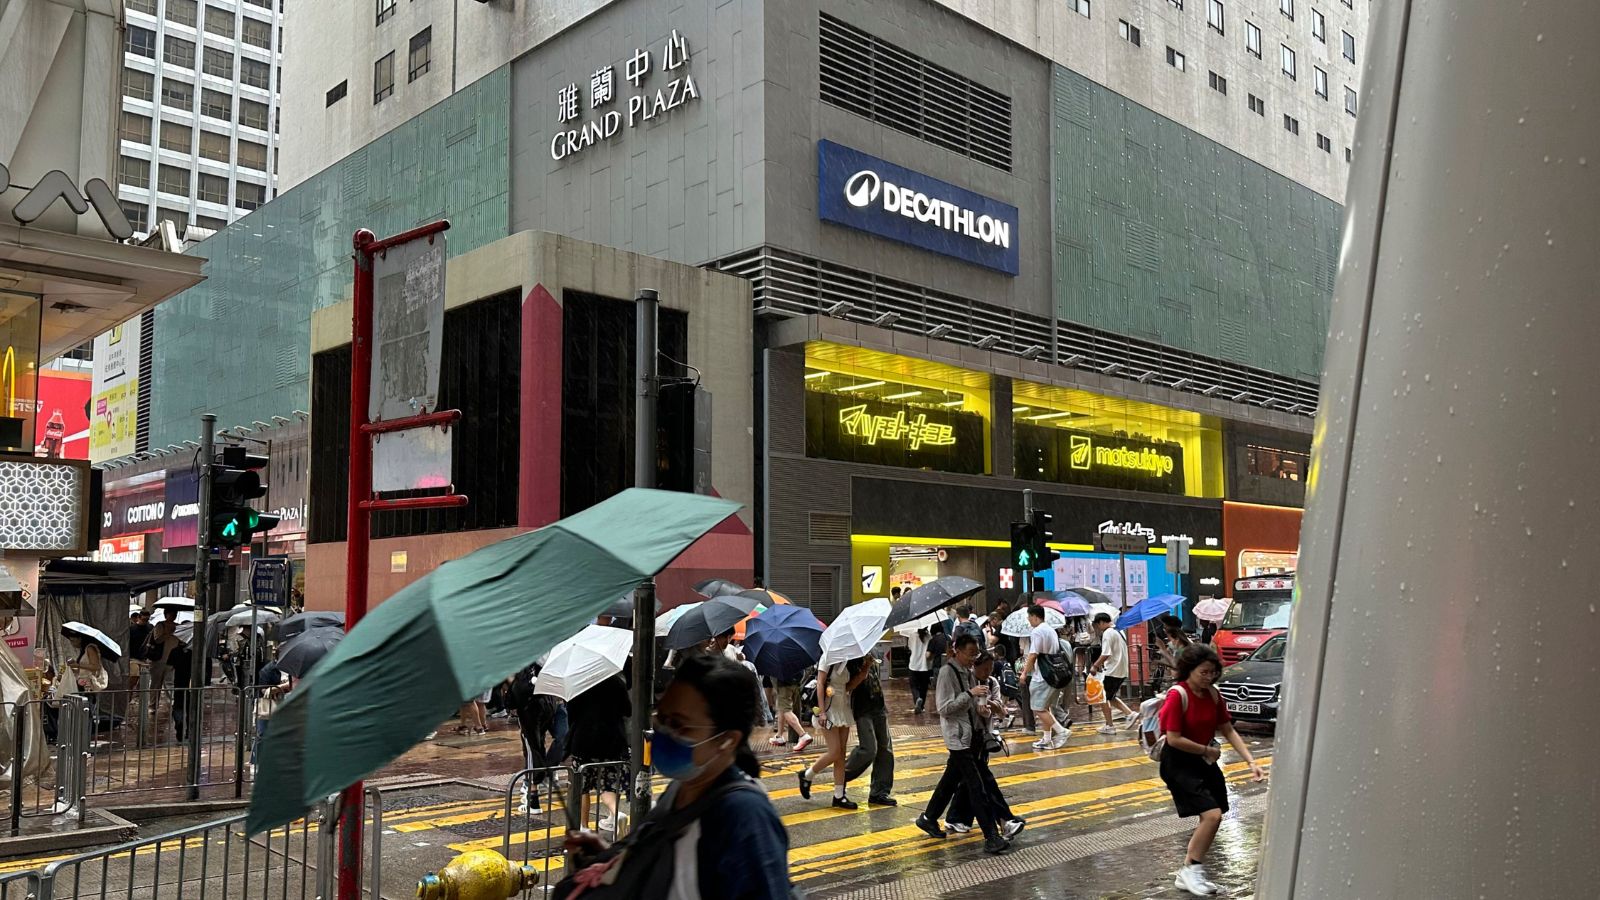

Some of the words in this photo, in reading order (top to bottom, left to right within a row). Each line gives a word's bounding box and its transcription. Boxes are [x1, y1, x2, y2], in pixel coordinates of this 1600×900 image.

[558, 29, 690, 123] 雅蘭中心
[551, 110, 621, 160] GRAND
[629, 74, 698, 127] PLAZA
[883, 181, 1010, 249] DECATHLON
[1096, 446, 1173, 477] matsukiyo
[128, 503, 158, 523] COTTON
[280, 507, 299, 520] PLAZA
[1238, 704, 1259, 712] 2268
